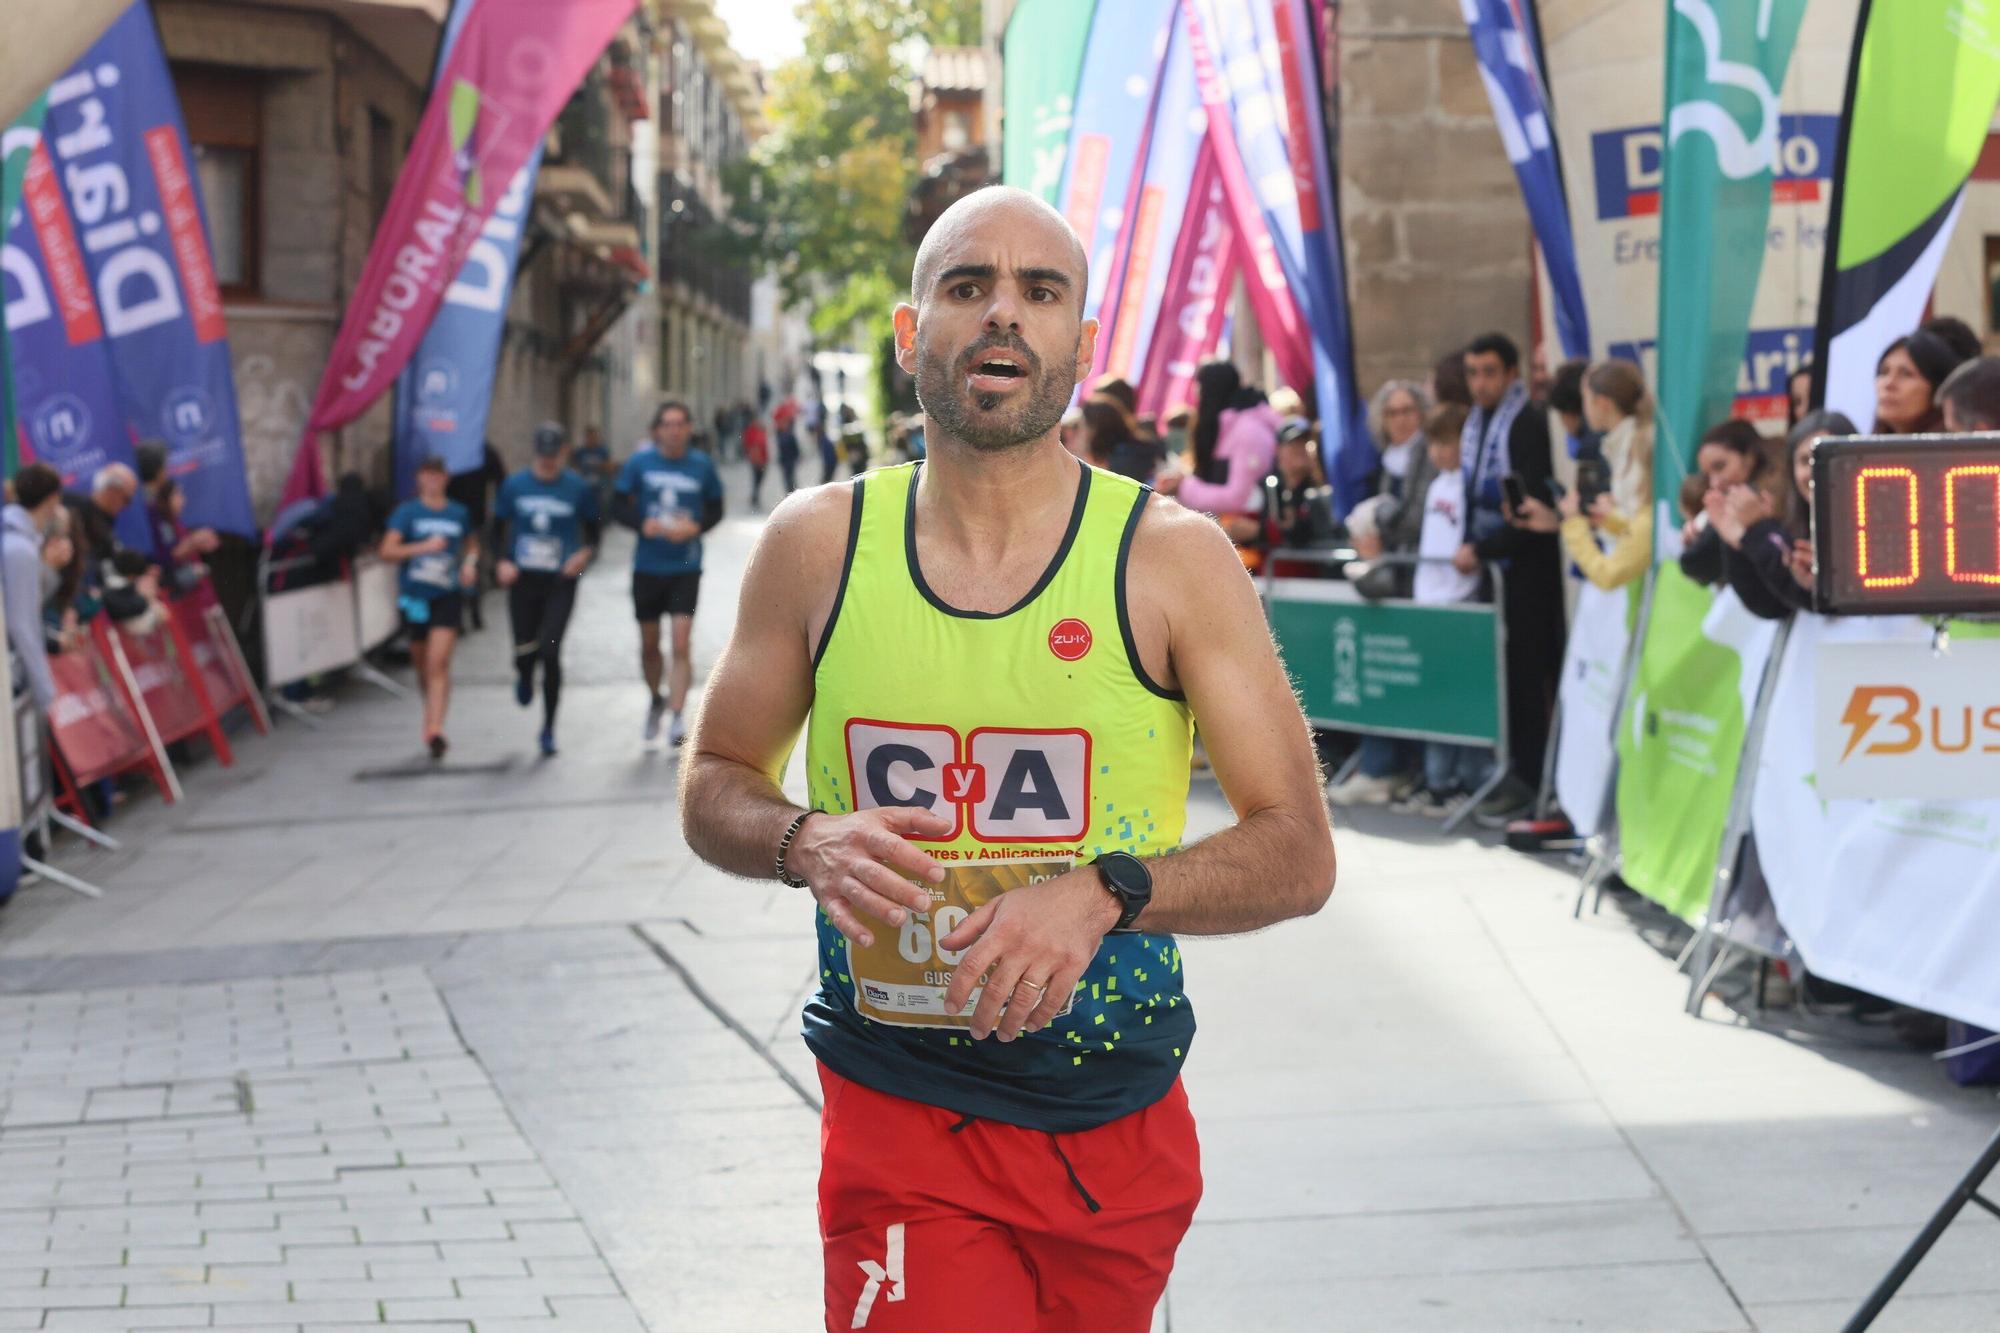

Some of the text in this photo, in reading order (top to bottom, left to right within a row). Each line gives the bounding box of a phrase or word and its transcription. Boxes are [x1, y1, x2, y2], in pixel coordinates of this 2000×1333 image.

[923, 849, 959, 861] ores
[978, 847, 1085, 860] Aplicaciones
[898, 905, 982, 966] 60
